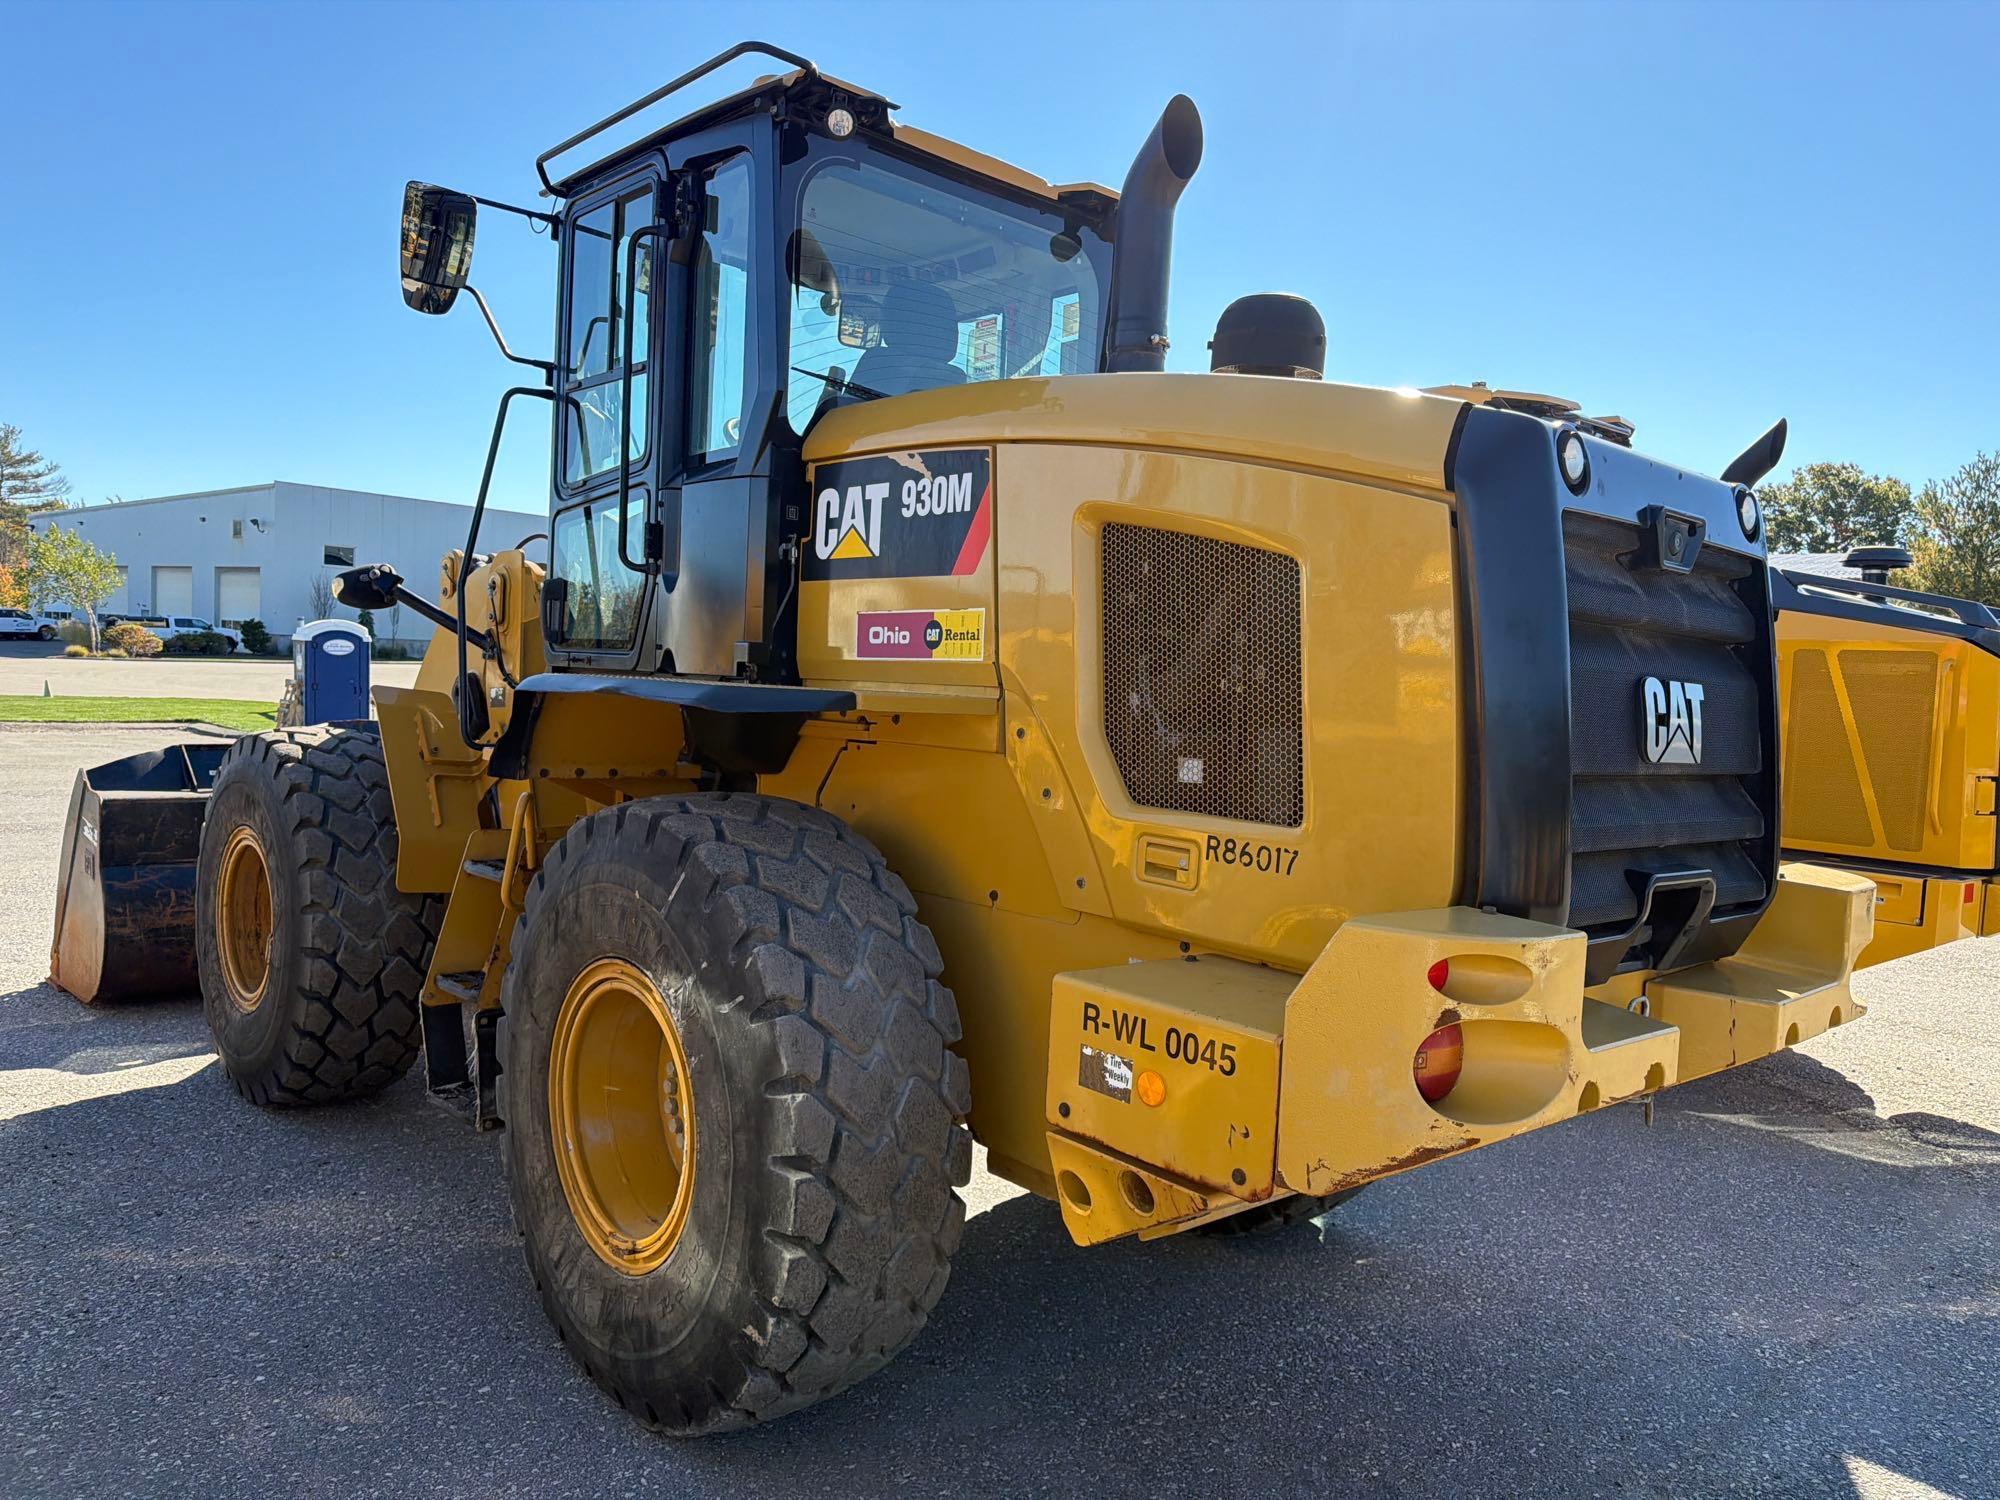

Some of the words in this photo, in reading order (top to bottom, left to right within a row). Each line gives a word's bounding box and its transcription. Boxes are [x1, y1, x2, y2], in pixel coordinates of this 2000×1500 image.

[815, 482, 890, 560] CAT
[901, 472, 973, 518] 930M
[868, 626, 910, 644] Ohio
[926, 628, 940, 641] CAT
[945, 628, 979, 641] Rental
[1644, 676, 1704, 763] CAT
[1205, 835, 1299, 875] R86017
[1082, 1002, 1156, 1052] R-WL
[1165, 1027, 1236, 1076] 0045
[1109, 1069, 1129, 1086] Weekly
[1110, 1055, 1122, 1069] Tire
